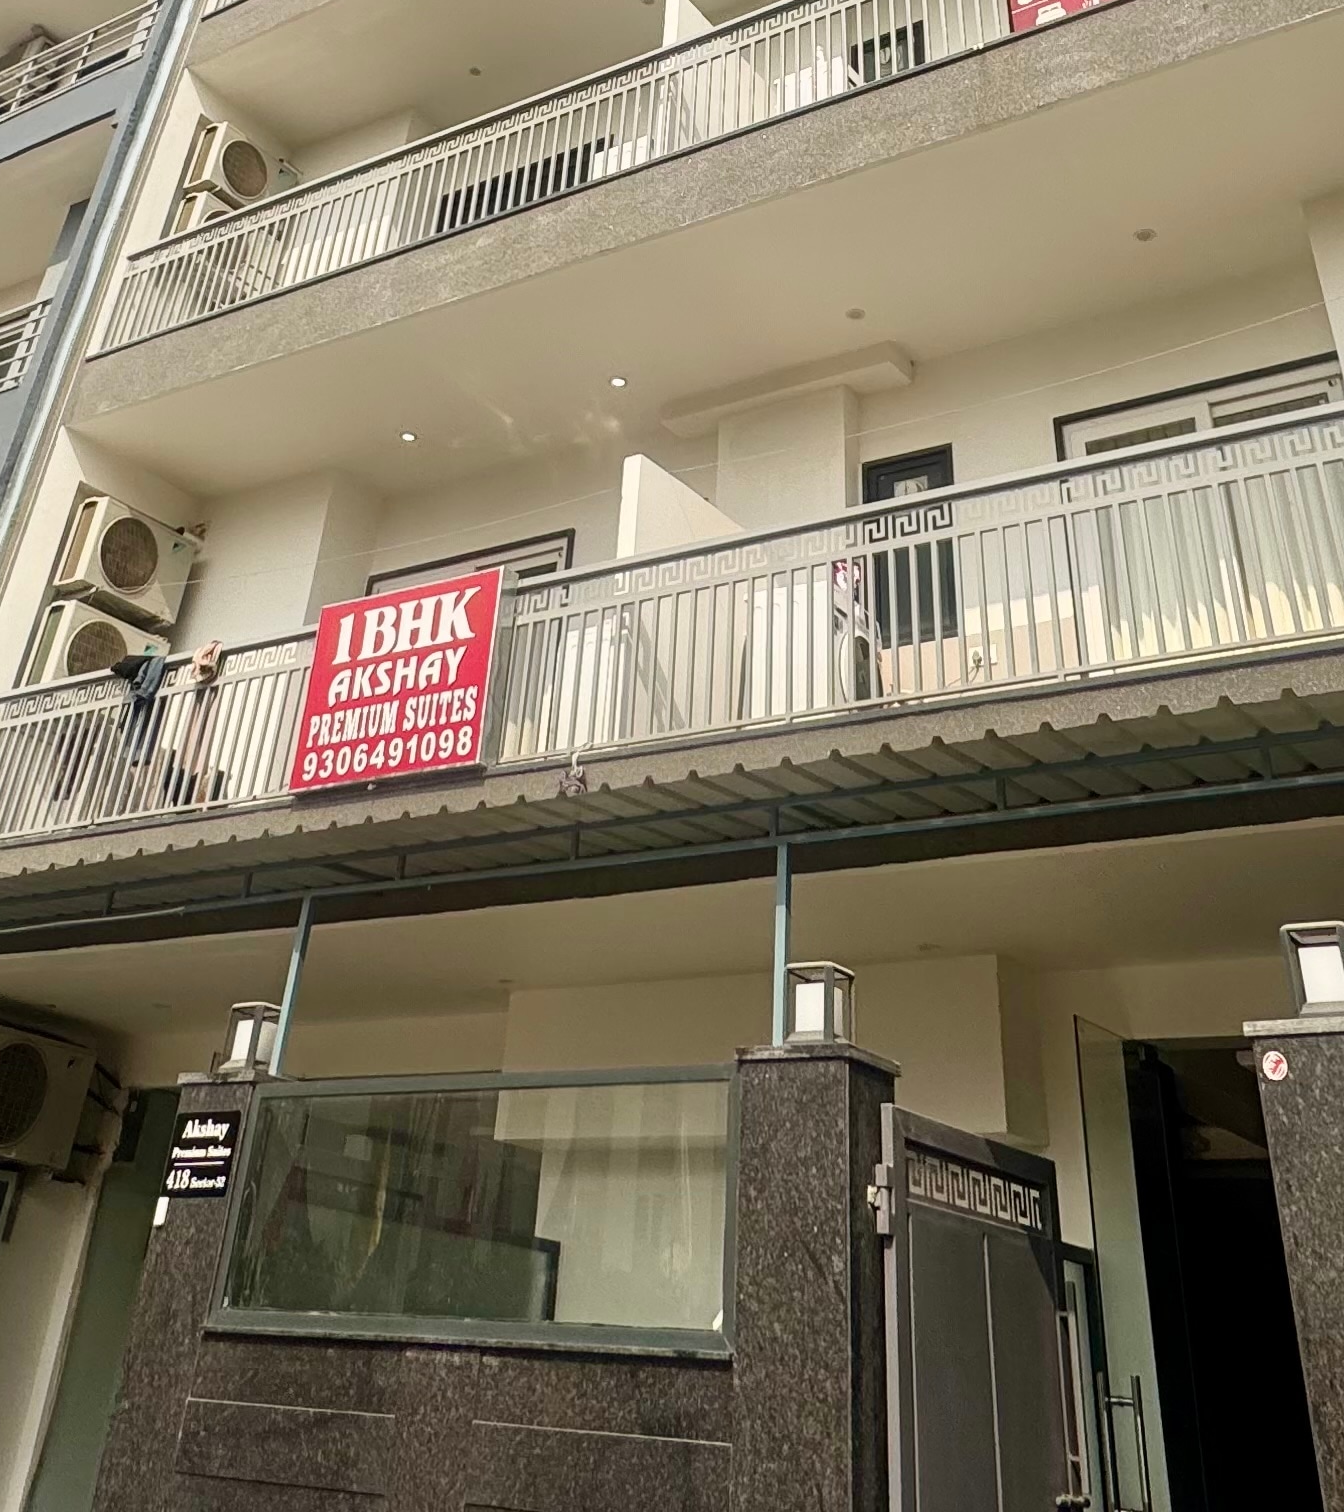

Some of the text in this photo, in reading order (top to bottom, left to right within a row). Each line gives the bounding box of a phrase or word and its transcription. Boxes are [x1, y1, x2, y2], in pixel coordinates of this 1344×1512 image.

[328, 646, 468, 707] AKSHAY
[306, 685, 478, 748] PREMIUM SUITES
[302, 726, 473, 781] 9306491098
[182, 1118, 230, 1141] Akshay
[165, 1169, 191, 1190] 418
